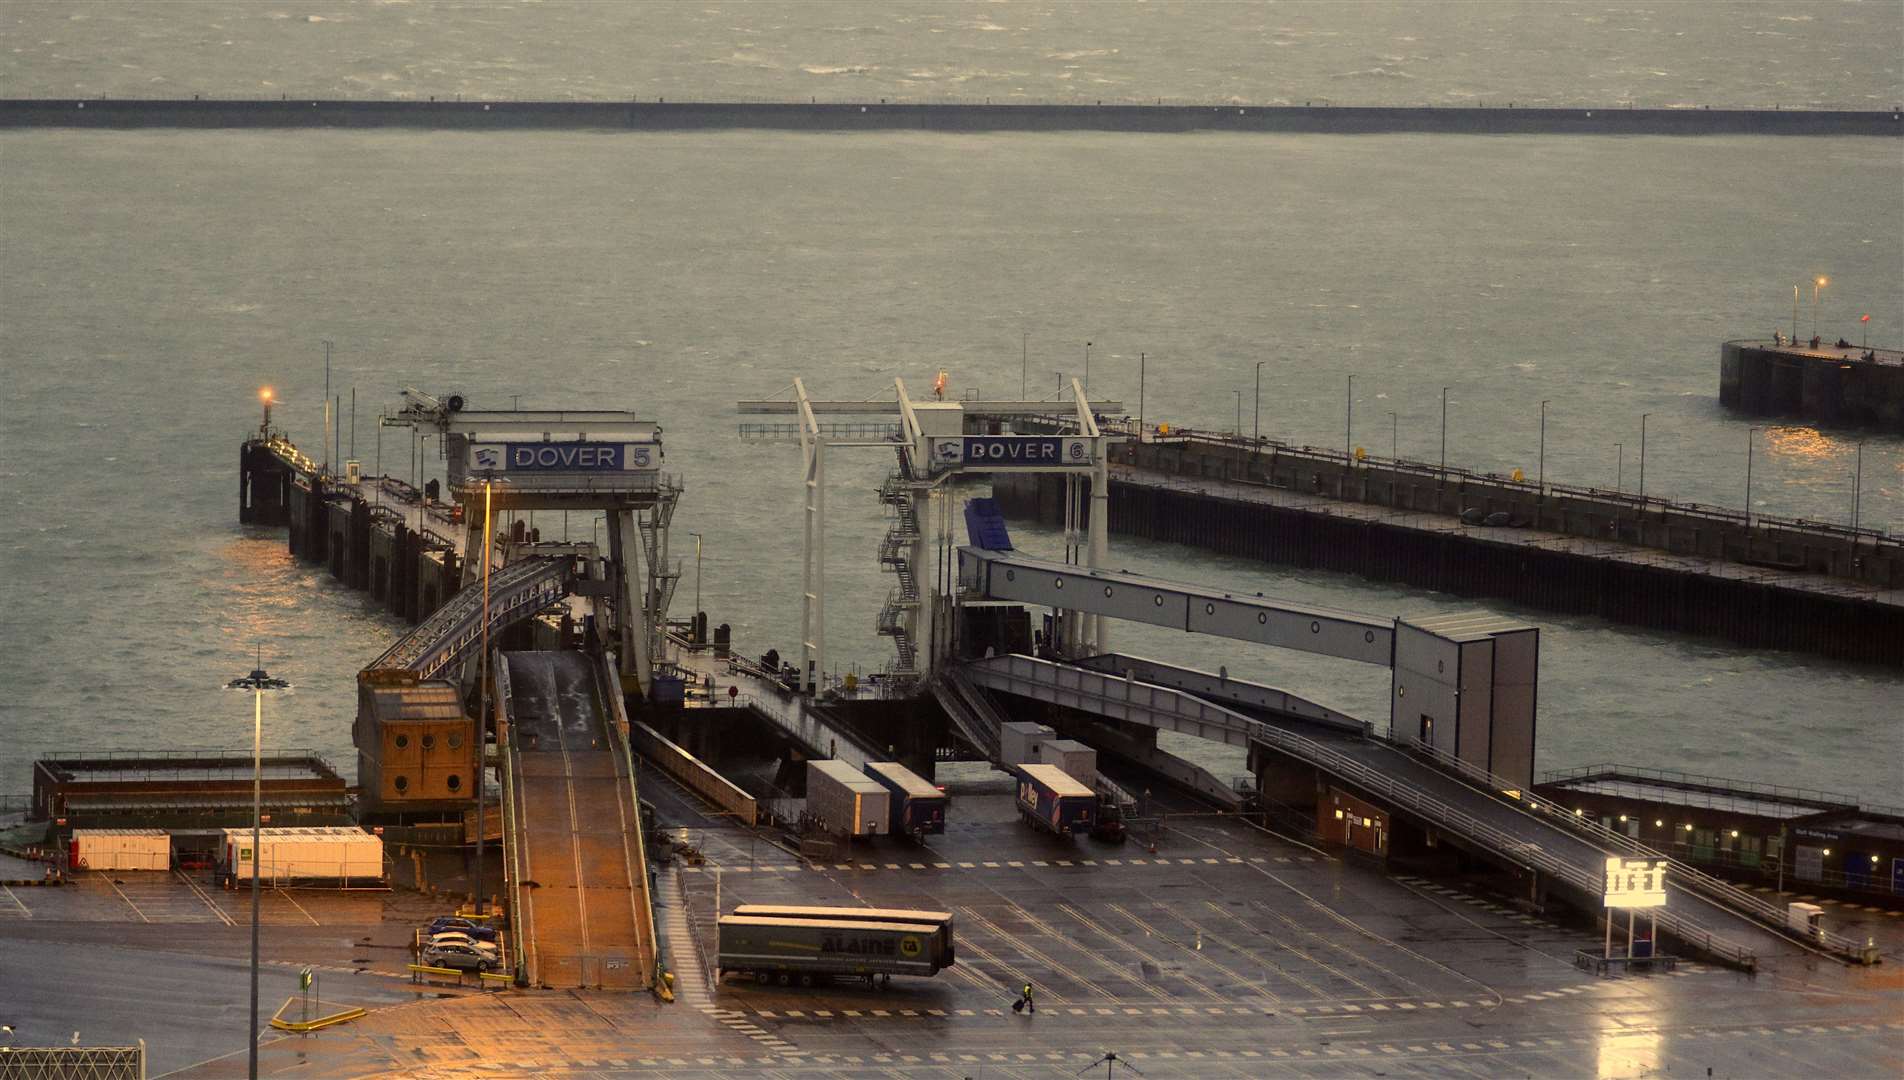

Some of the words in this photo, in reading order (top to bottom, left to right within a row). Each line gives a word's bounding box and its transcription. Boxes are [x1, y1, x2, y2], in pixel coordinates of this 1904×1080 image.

[515, 447, 616, 466] DOVER
[633, 448, 650, 467] 5
[971, 442, 1055, 459] DOVER
[1070, 442, 1085, 458] 6
